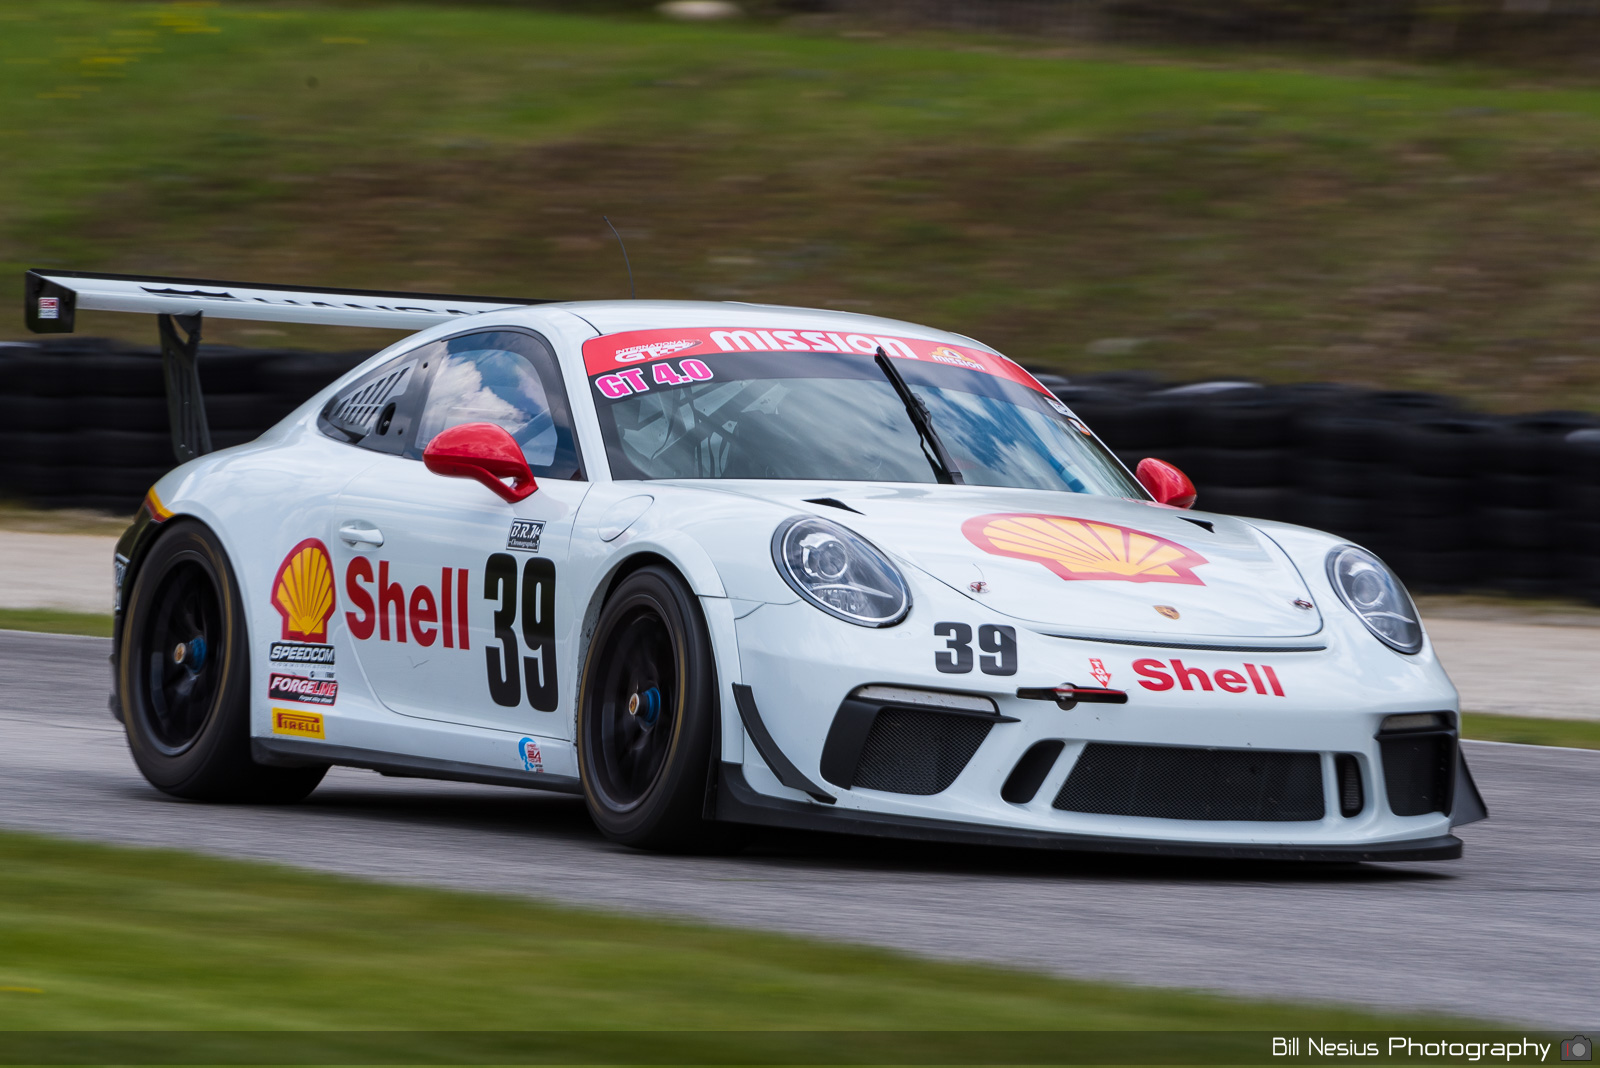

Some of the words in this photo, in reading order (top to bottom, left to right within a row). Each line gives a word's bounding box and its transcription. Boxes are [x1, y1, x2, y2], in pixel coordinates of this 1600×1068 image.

[616, 339, 686, 354] INTERNATIONAL
[595, 367, 649, 399] GT
[652, 359, 713, 385] 4.0
[345, 556, 470, 650] Shell
[484, 552, 558, 713] 39
[270, 645, 334, 663] SPEEDCOM
[934, 621, 1018, 676] 39
[271, 676, 337, 696] FORGELINE
[1092, 661, 1108, 682] TOW
[1132, 658, 1286, 698] Shell
[276, 712, 320, 733] PIRELLI
